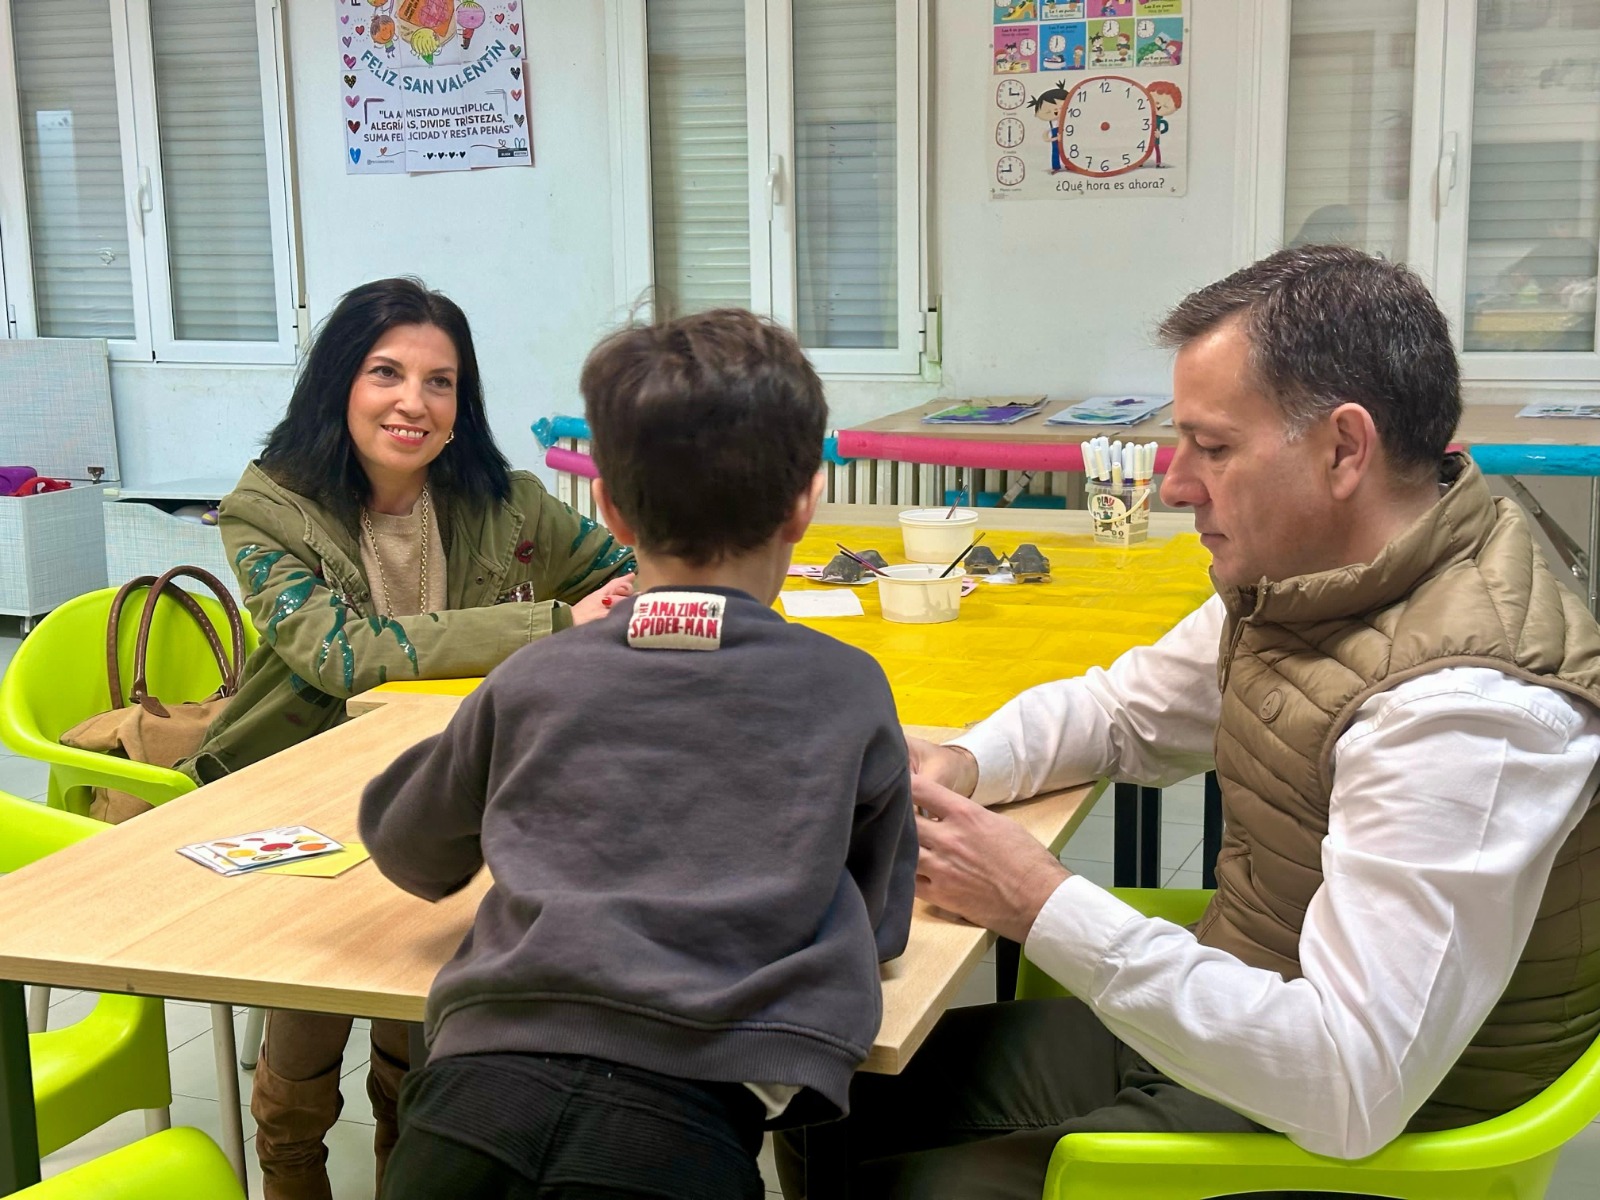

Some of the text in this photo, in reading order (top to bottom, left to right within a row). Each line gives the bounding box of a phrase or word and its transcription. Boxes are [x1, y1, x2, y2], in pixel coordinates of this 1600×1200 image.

[360, 39, 506, 94] FELIZ SAN VALENTÍN
[1099, 82, 1111, 93] 12
[1125, 87, 1130, 99] 1
[1077, 91, 1087, 102] 11
[395, 107, 440, 118] AMISTAD
[441, 102, 495, 116] MULTIPLICA
[1137, 99, 1145, 110] 2
[1067, 108, 1081, 118] 10
[420, 117, 451, 128] DIVIDE
[455, 114, 505, 127] TRISTEZAS,
[1141, 119, 1150, 131] 3
[363, 133, 390, 142] SUMA
[391, 130, 440, 142] FELICIDAD
[442, 130, 448, 139] Y
[450, 126, 479, 139] RESTA
[1065, 125, 1074, 137] 9
[1069, 144, 1079, 159] 8
[1137, 140, 1145, 152] 4
[1085, 157, 1092, 169] 7
[1100, 160, 1109, 172] 6
[1122, 154, 1130, 166] 5
[1056, 178, 1165, 192] ¿Qué hora es ahora?
[649, 601, 709, 618] AMAZING
[630, 617, 718, 639] SPIDER-MAN
